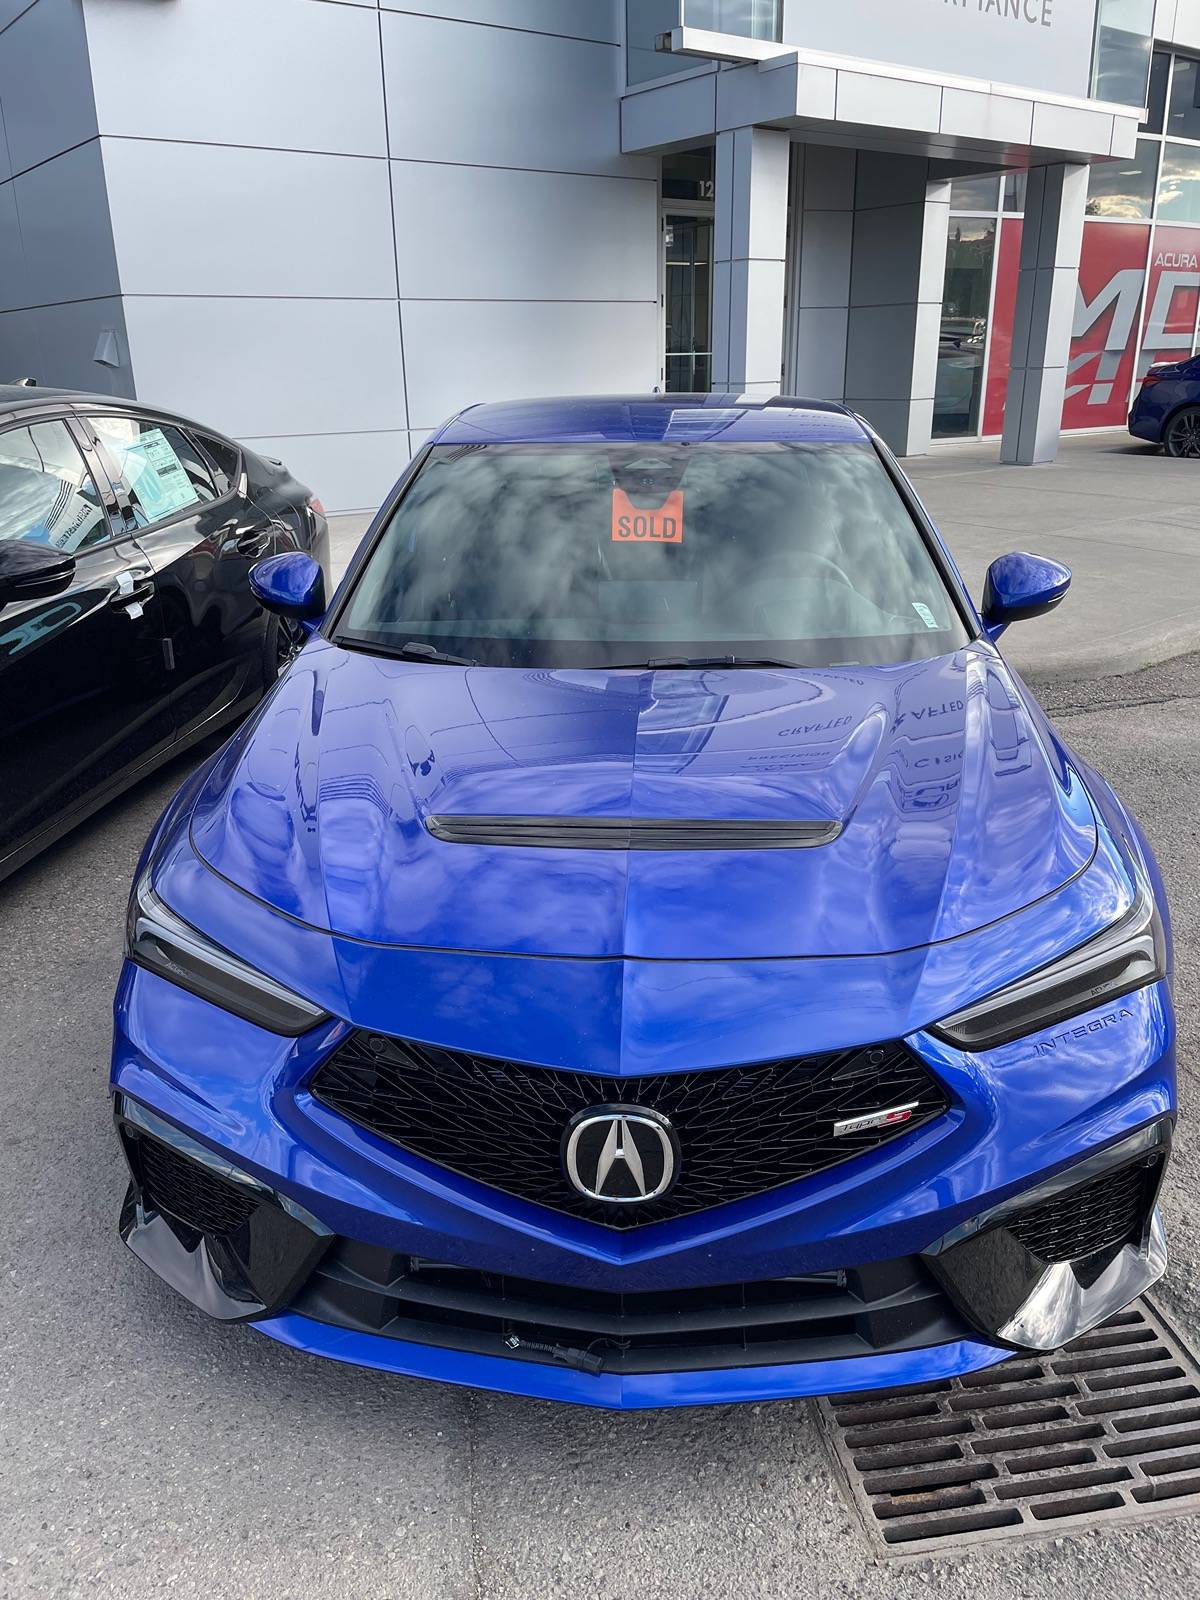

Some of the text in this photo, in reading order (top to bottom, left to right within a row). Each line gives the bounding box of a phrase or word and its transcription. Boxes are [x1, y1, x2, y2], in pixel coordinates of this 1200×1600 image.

[1154, 252, 1198, 268] ACURA
[618, 515, 677, 538] SOLD
[1034, 1009, 1133, 1056] INTEGRA
